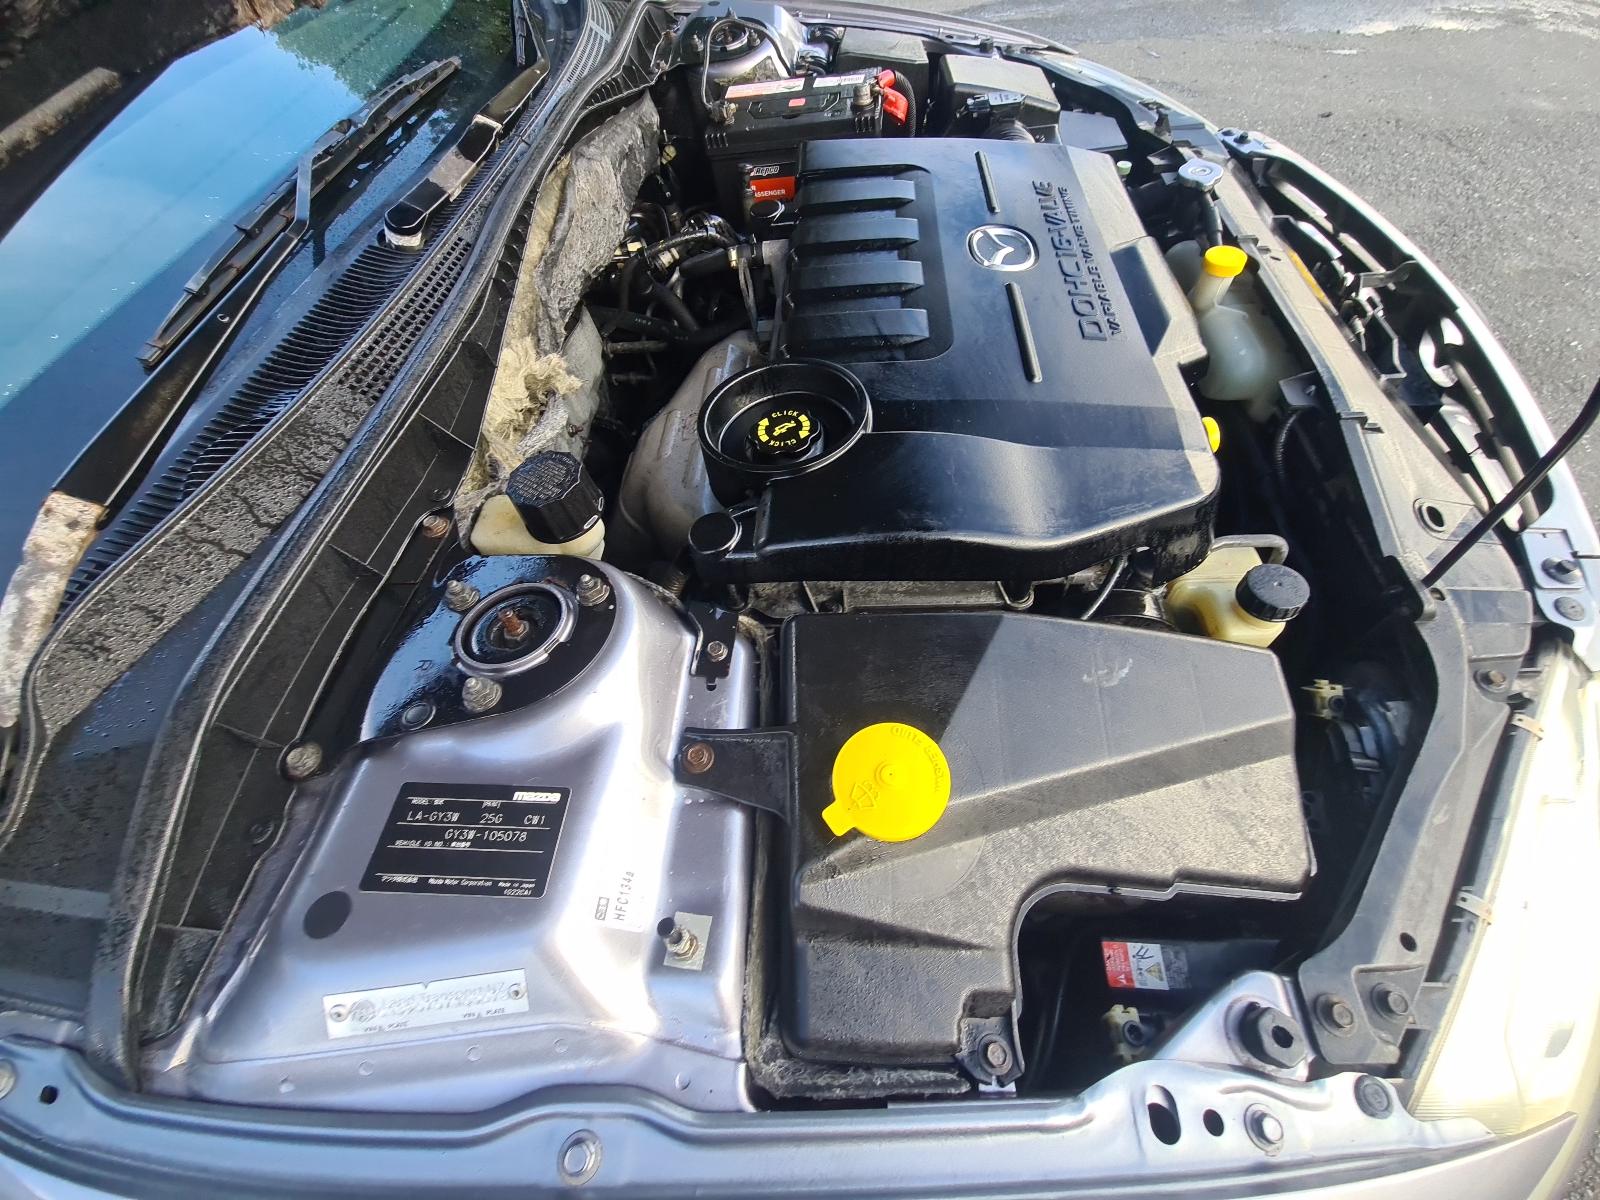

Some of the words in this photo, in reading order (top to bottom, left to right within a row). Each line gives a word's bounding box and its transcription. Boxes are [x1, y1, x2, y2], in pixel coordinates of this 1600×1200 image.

[1058, 261, 1108, 342] DOHC
[771, 410, 799, 418] CLICK
[768, 438, 797, 447] CLICK
[512, 791, 562, 803] mazda
[406, 810, 460, 822] LA-GY3W
[479, 813, 503, 824] 25G
[523, 814, 546, 825] CW1
[444, 829, 528, 843] GY3W-105078
[612, 871, 634, 921] HFC134a
